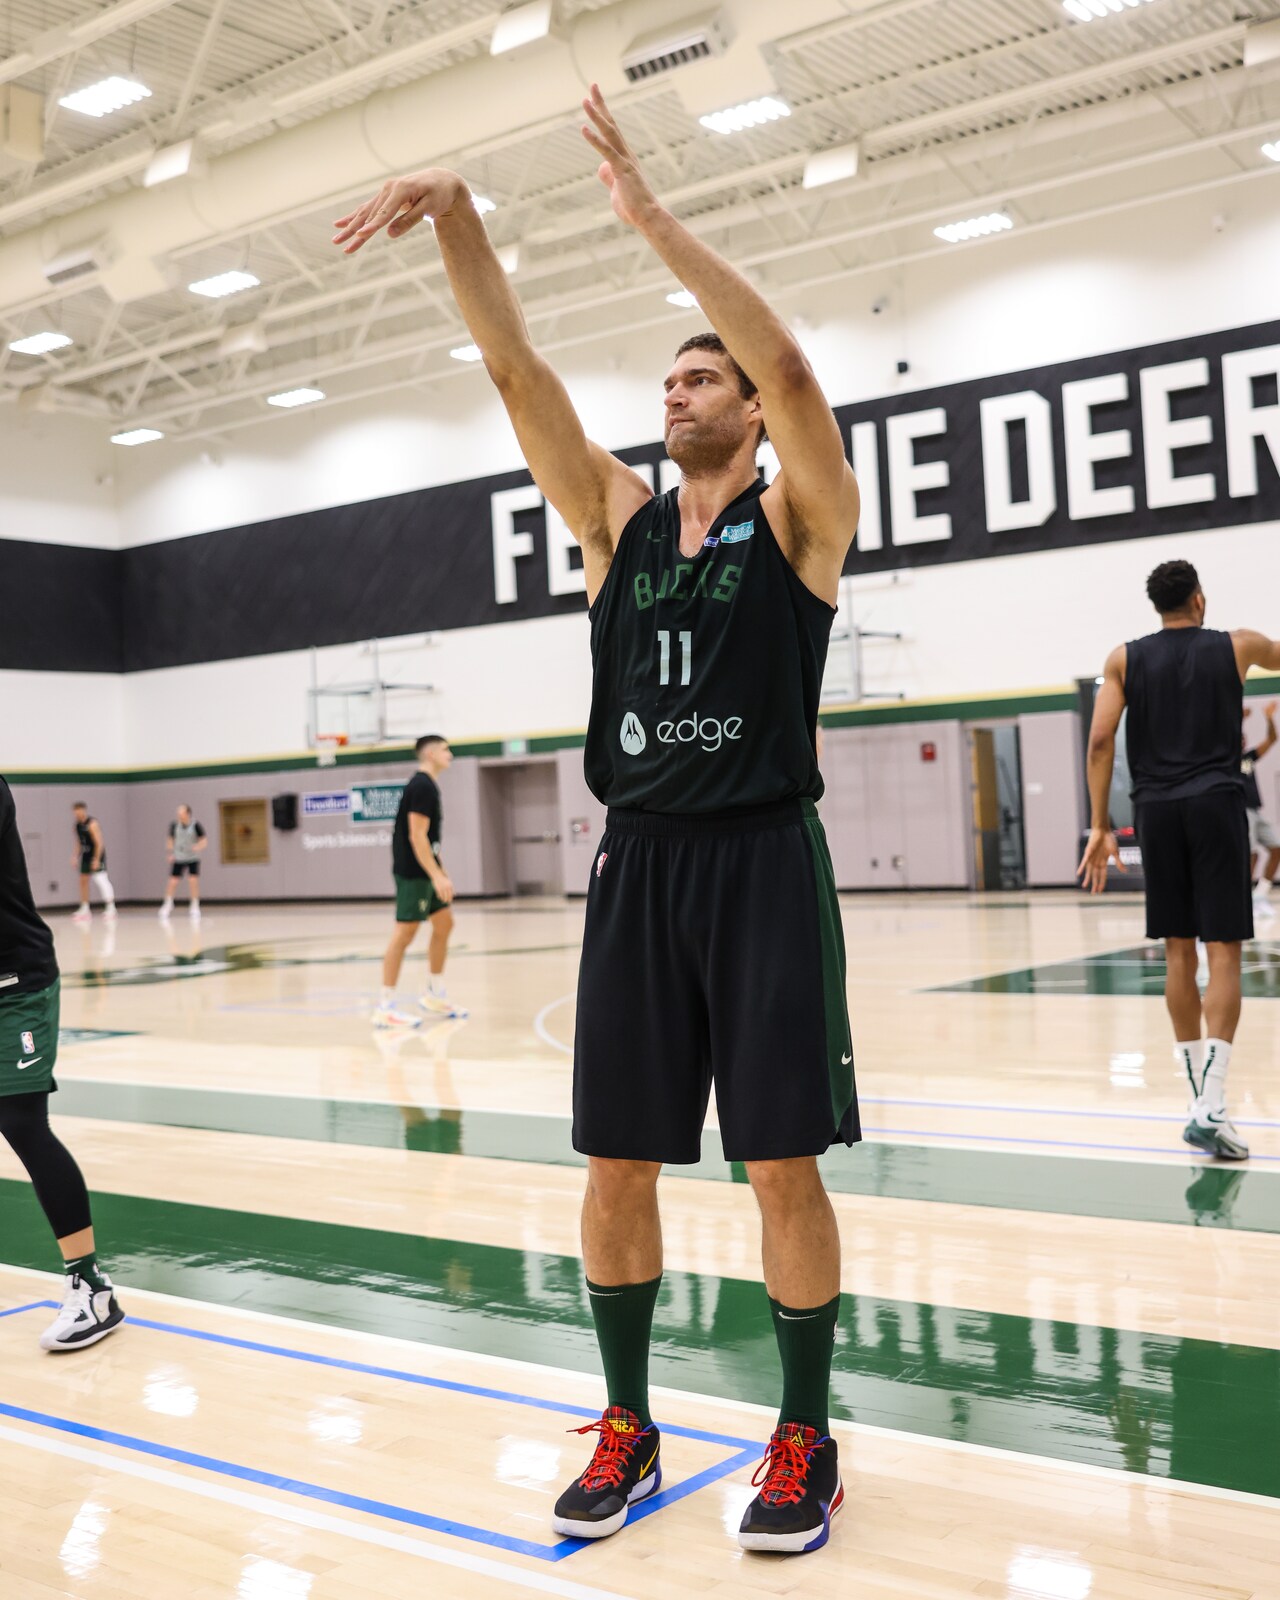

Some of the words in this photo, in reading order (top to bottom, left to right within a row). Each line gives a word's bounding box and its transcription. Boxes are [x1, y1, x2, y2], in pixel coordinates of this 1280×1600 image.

[979, 343, 1280, 534] DEER
[657, 630, 692, 686] 11
[656, 711, 743, 752] edge
